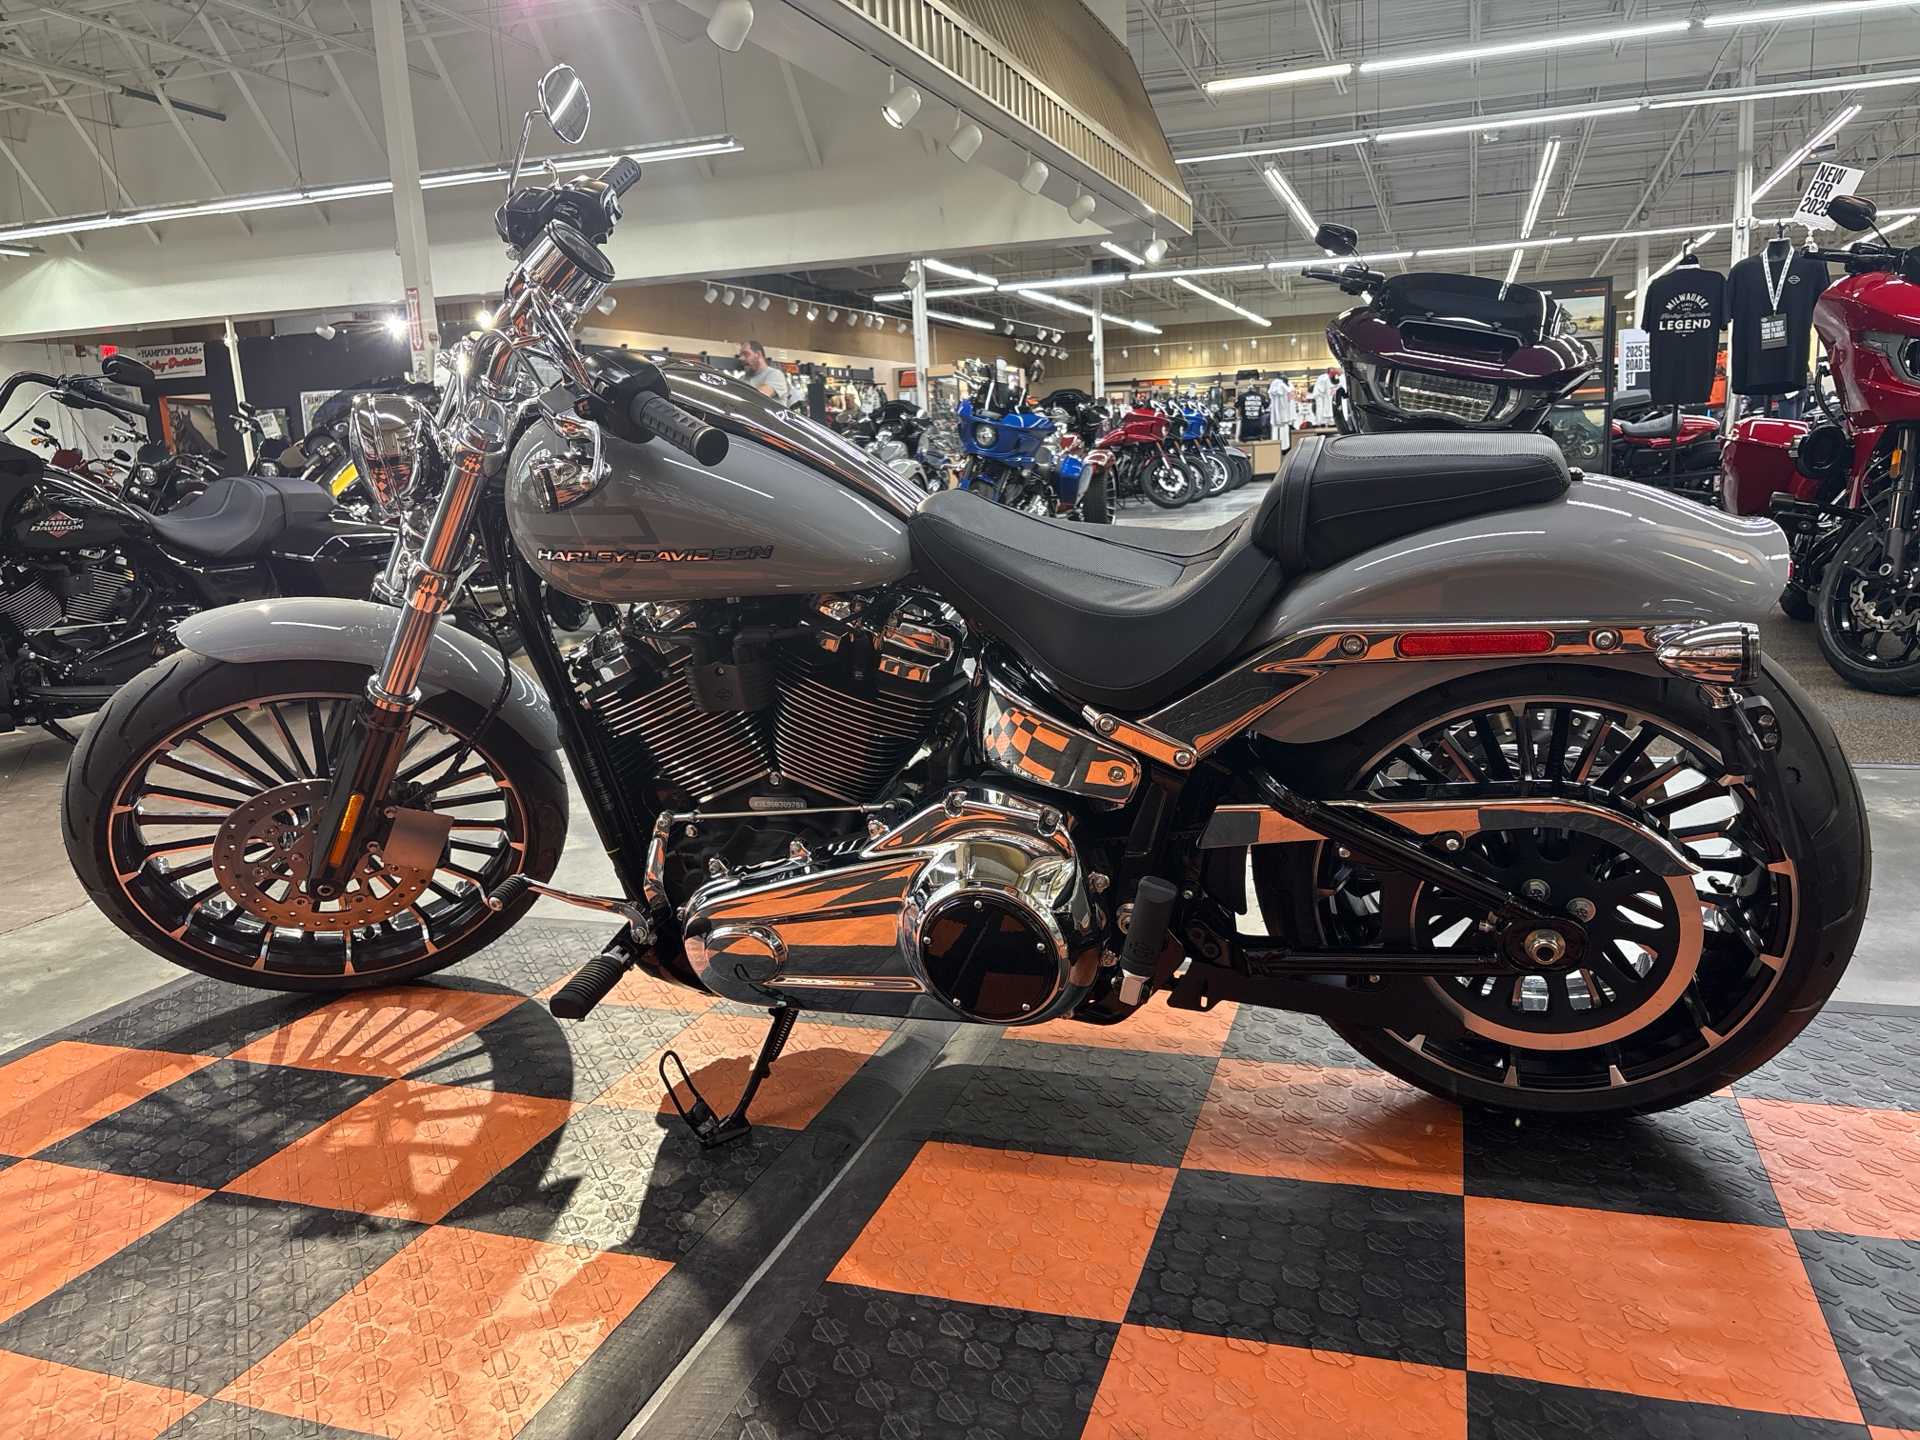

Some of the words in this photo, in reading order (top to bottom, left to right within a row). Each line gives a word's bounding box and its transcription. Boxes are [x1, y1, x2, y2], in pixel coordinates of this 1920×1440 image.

[1816, 164, 1847, 185] NEW
[1808, 181, 1833, 200] FOR
[1800, 197, 1831, 217] 2025
[1665, 292, 1709, 311] MILWAUKEE
[1659, 318, 1711, 331] LEGEND
[141, 348, 173, 358] HAMPTON
[174, 346, 198, 355] ROADS
[1625, 345, 1643, 358] 2025
[1625, 358, 1643, 371] ROAD
[1626, 371, 1634, 385] ST
[30, 523, 84, 532] DAVIDSON
[36, 518, 84, 527] HARLEY
[537, 545, 774, 563] HARLEY-DAVIDSON
